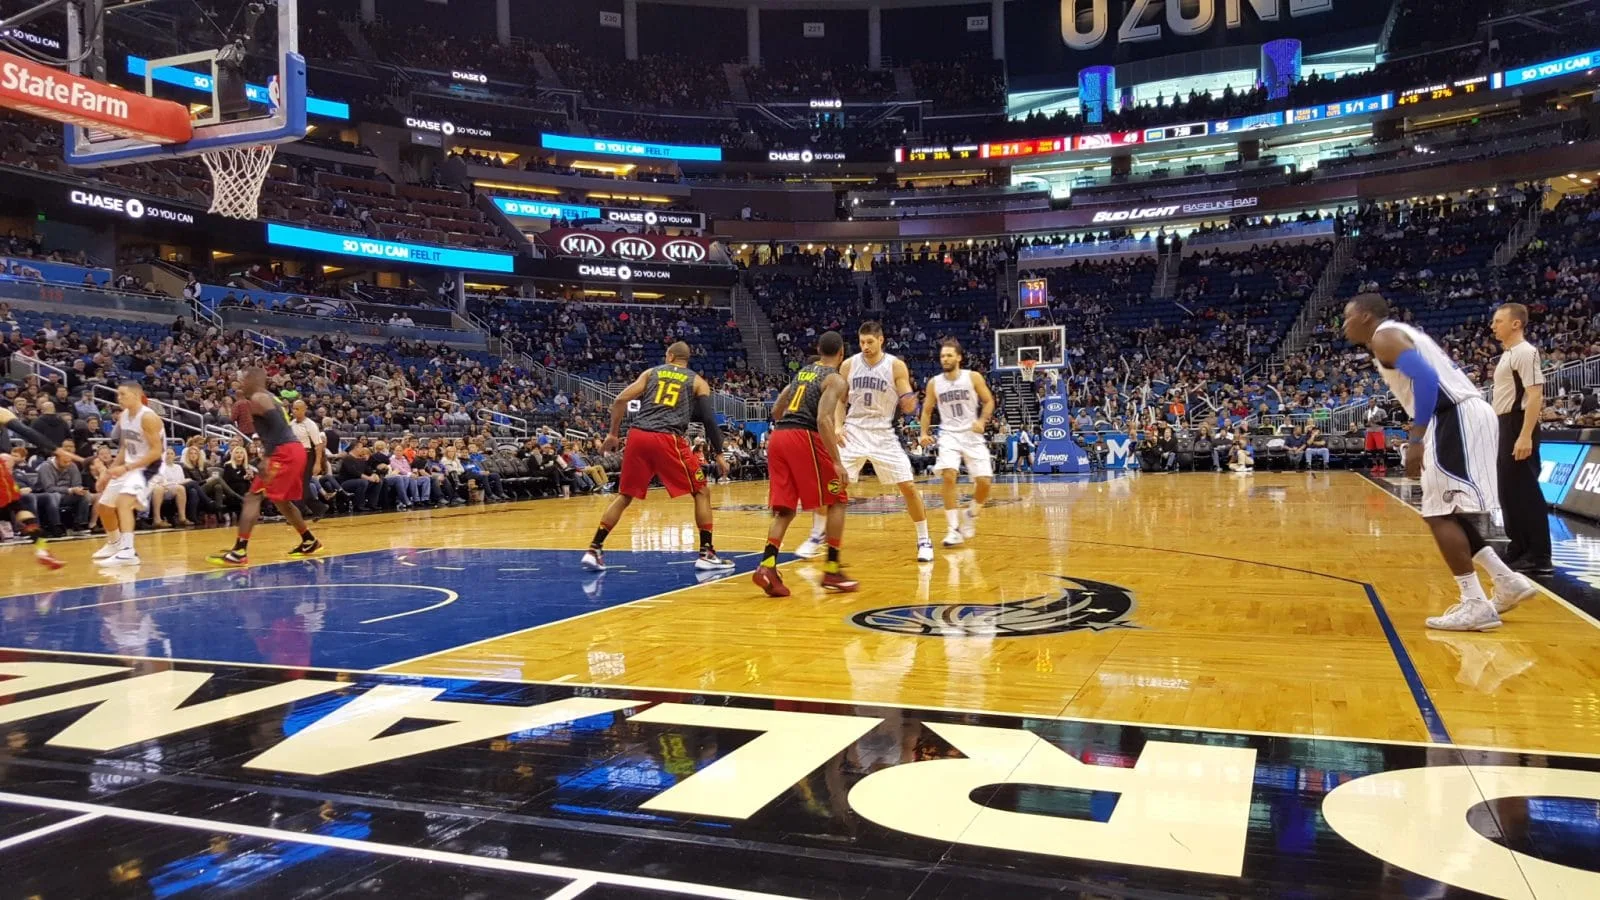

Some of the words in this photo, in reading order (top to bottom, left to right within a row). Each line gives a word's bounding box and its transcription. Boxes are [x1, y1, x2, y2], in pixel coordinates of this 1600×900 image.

[1060, 0, 1335, 50] OZO
[13, 29, 24, 39] SO
[25, 33, 41, 44] YOU
[42, 38, 60, 49] CAN
[1521, 69, 1537, 80] SO
[1539, 63, 1563, 76] YOU
[1564, 56, 1590, 70] CAN
[452, 71, 479, 81] CHASE
[1432, 89, 1452, 99] 27%
[406, 118, 441, 131] CHASE
[456, 126, 466, 134] SO
[479, 129, 492, 137] CAN
[594, 142, 606, 151] SO
[607, 143, 625, 152] YOU
[625, 145, 645, 154] CAN
[770, 152, 800, 161] CHASE
[71, 190, 124, 212] CHASE
[147, 207, 159, 217] SO
[159, 209, 177, 221] YOU
[177, 213, 194, 224] CAN
[519, 203, 539, 215] YOU
[540, 205, 561, 217] CAN
[1091, 210, 1130, 223] BUD
[1128, 205, 1181, 220] LIGHT
[1182, 200, 1233, 213] BASELINE
[608, 212, 644, 222] CHASE
[658, 215, 667, 223] SO
[342, 240, 358, 252] SO
[360, 242, 383, 255] YOU
[384, 245, 409, 258] CAN
[410, 249, 431, 260] FEEL
[432, 252, 442, 261] IT
[567, 237, 598, 253] KIA
[619, 242, 649, 257] KIA
[669, 244, 699, 259] KIA
[578, 265, 617, 277] CHASE
[643, 270, 657, 278] YOU
[657, 271, 671, 279] CAN
[852, 375, 888, 393] MAGIC
[654, 380, 681, 407] 15
[939, 389, 970, 405] MAGIC
[950, 403, 964, 418] 10
[1047, 430, 1064, 438] KIA
